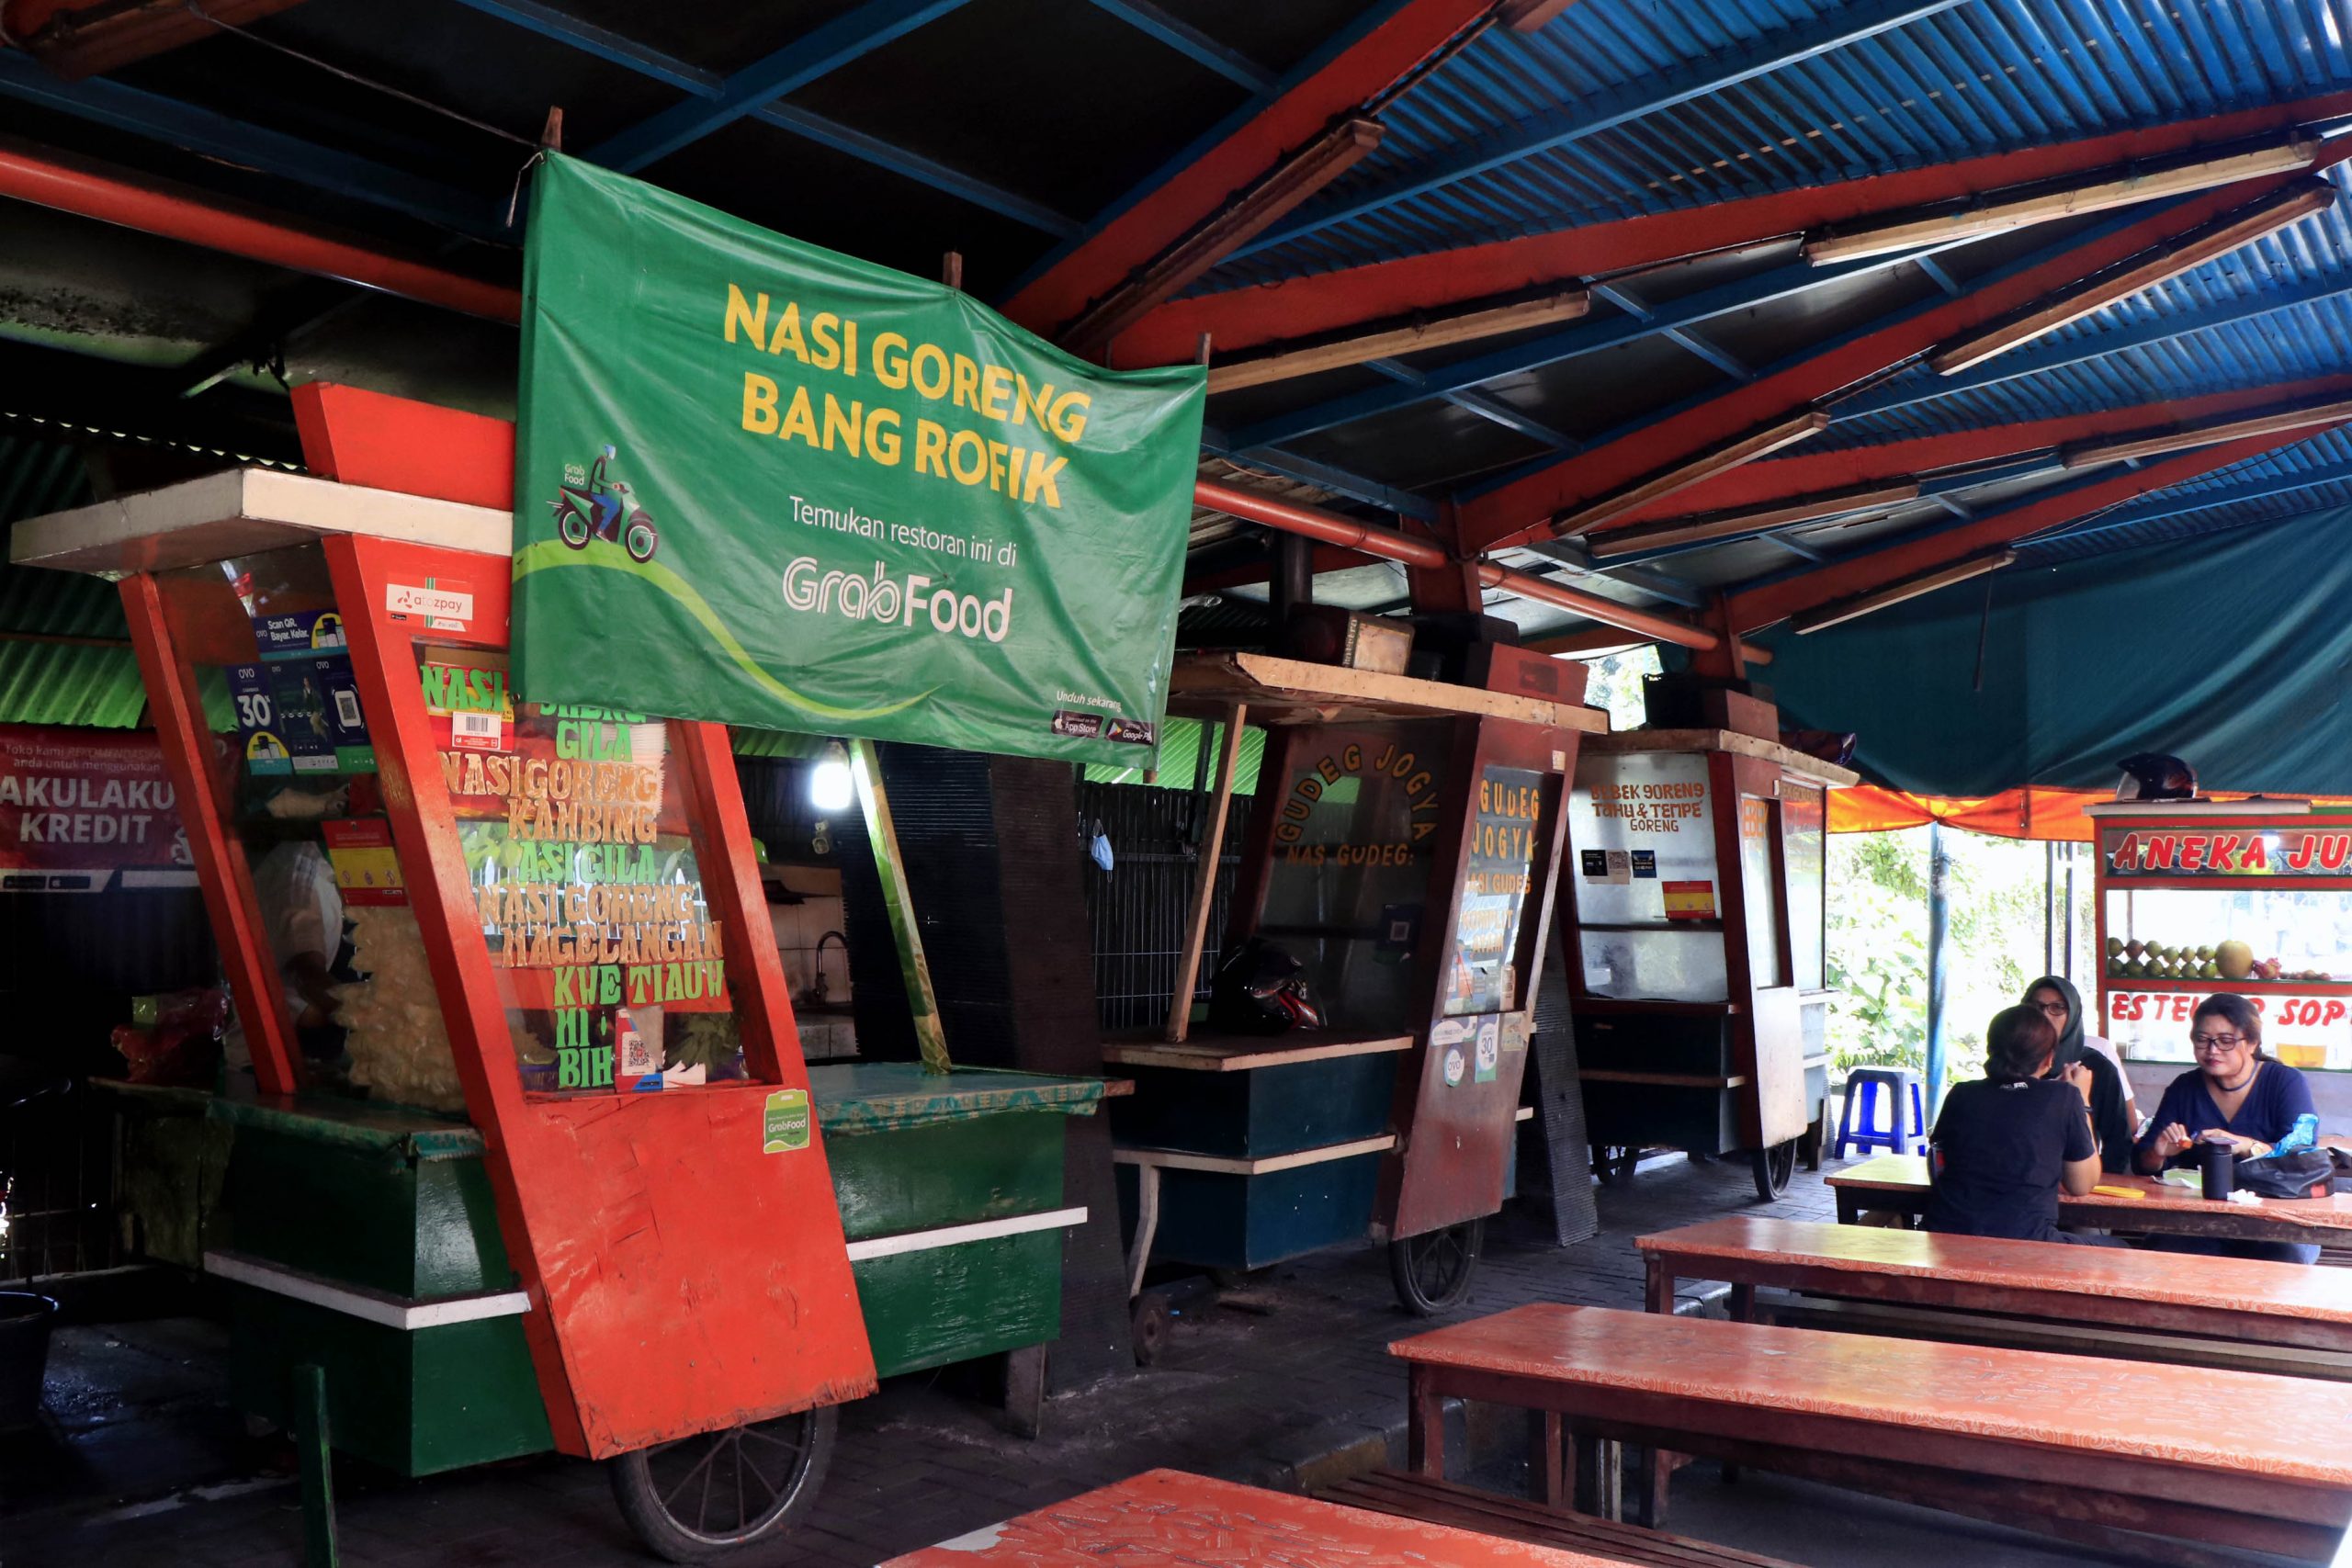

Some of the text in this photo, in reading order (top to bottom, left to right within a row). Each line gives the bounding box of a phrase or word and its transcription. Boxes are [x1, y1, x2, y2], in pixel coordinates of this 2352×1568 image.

[724, 283, 1091, 443] NASI GORENG
[741, 371, 1069, 508] BANG ROFIK
[564, 463, 585, 476] Grab
[564, 473, 584, 486] Food
[789, 495, 1017, 567] Temukan restoran ini di
[783, 557, 1012, 643] GrabFood
[267, 620, 284, 630] Scan
[238, 668, 254, 679] OVO
[316, 660, 329, 670] OVO
[420, 665, 504, 711] NASI
[1057, 690, 1122, 713] Unduh sekarang
[556, 719, 633, 762] GILA
[1065, 721, 1097, 734] App Store
[6, 745, 33, 755] Toko
[36, 746, 64, 757] kami
[14, 758, 161, 773] anda untuk menggunakan
[0, 775, 175, 809] AKULAKU
[436, 751, 657, 804] NASI GORENG
[1275, 743, 1440, 842] GUDEG JOGYA
[1479, 779, 1540, 821] GUDEG
[20, 813, 152, 844] KREDIT
[507, 796, 658, 844] KAMBING
[1630, 818, 1679, 833] GORENG
[1472, 821, 1534, 862] JOGYA
[2113, 832, 2352, 871] ANEKA JU
[580, 843, 657, 885] GILA
[479, 883, 695, 926] NASI GORENG
[502, 919, 724, 968] MAGELANGAN
[552, 959, 725, 1007] KWE TIAUW
[2111, 993, 2148, 1021] ES
[2278, 998, 2352, 1027] SOP
[1448, 1060, 1461, 1071] OVO
[1481, 1037, 1493, 1055] 30
[558, 1045, 615, 1089] BIH
[768, 1117, 806, 1133] GrabFood
